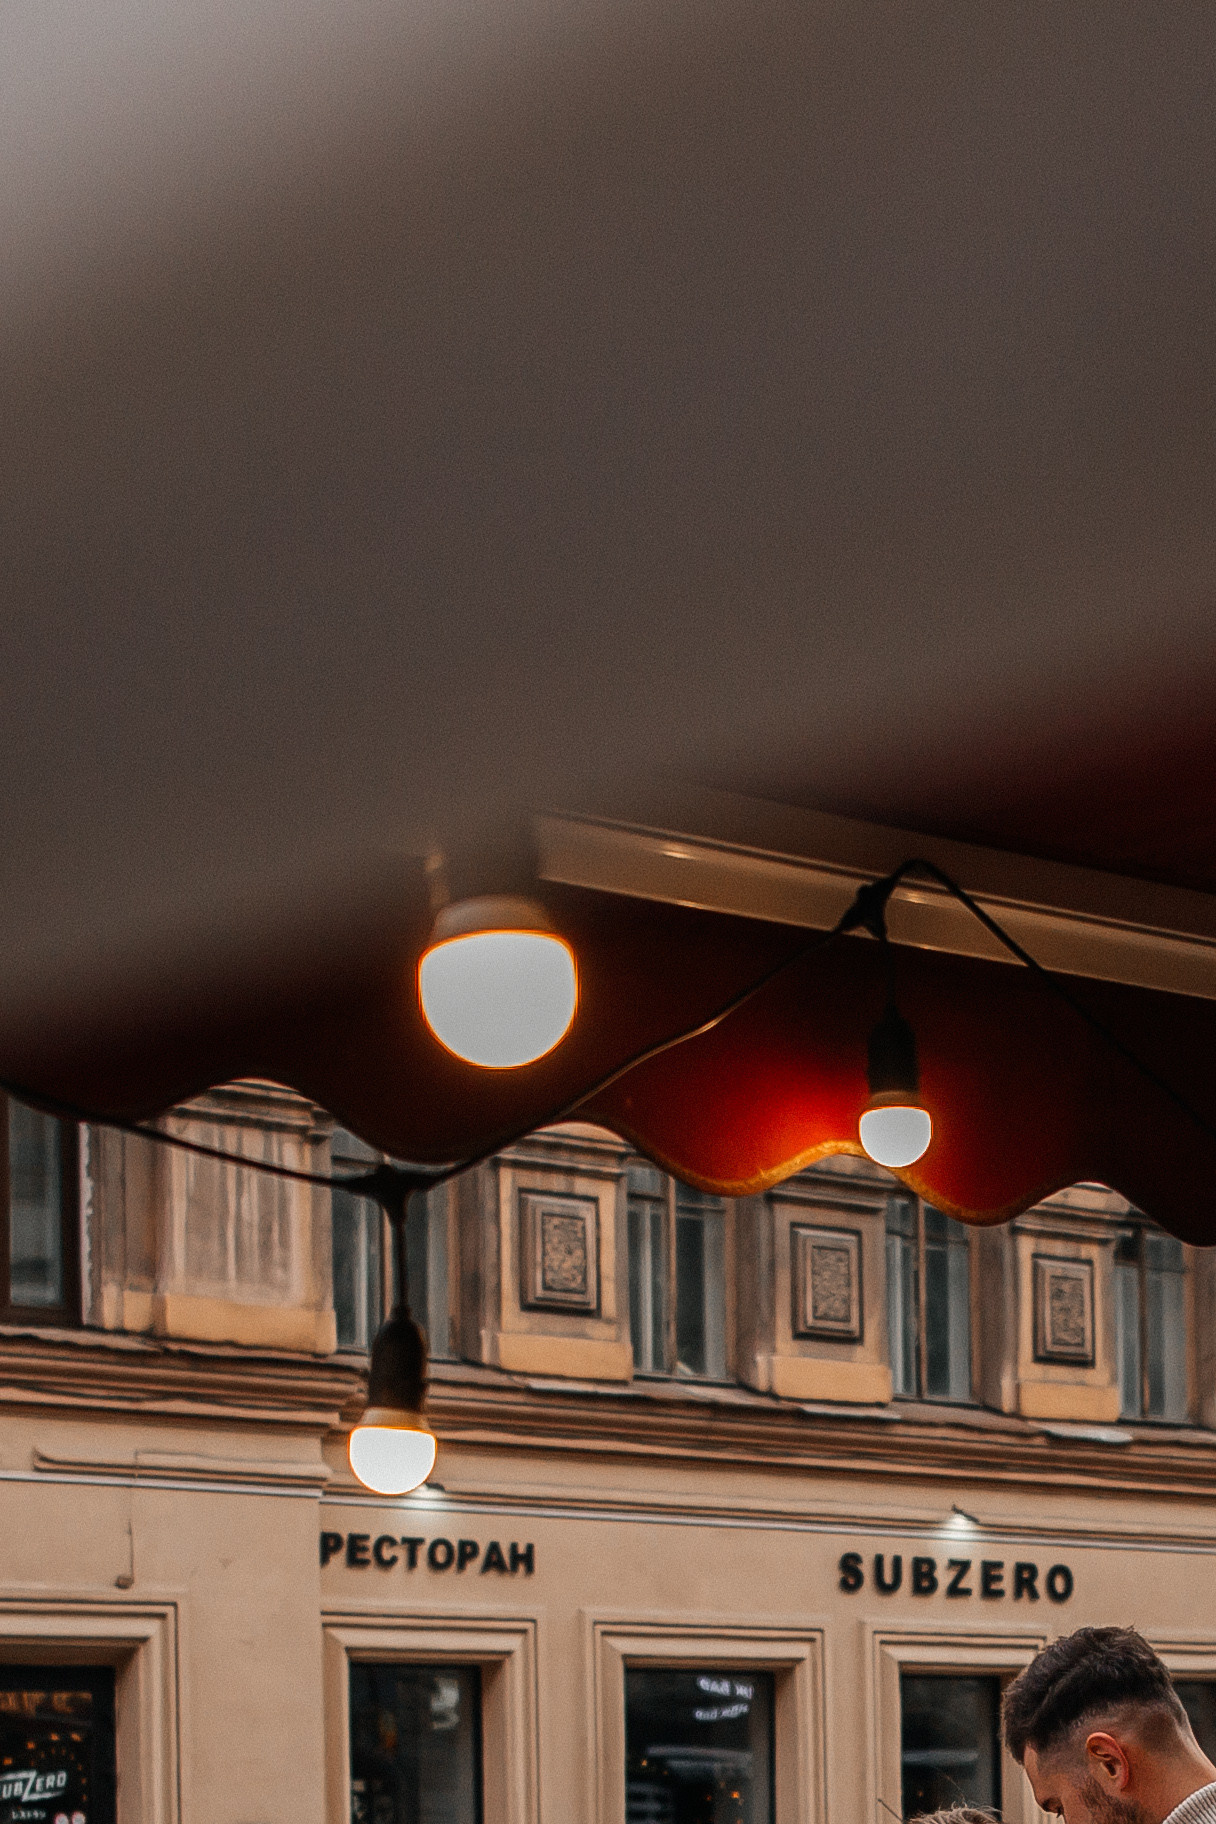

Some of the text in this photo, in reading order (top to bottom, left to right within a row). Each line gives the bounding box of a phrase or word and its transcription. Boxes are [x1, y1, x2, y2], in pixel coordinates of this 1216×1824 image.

[319, 1531, 535, 1575] РЕСТОРАН
[838, 1551, 1074, 1603] SUBZERO
[0, 1770, 67, 1802] UBZERO
